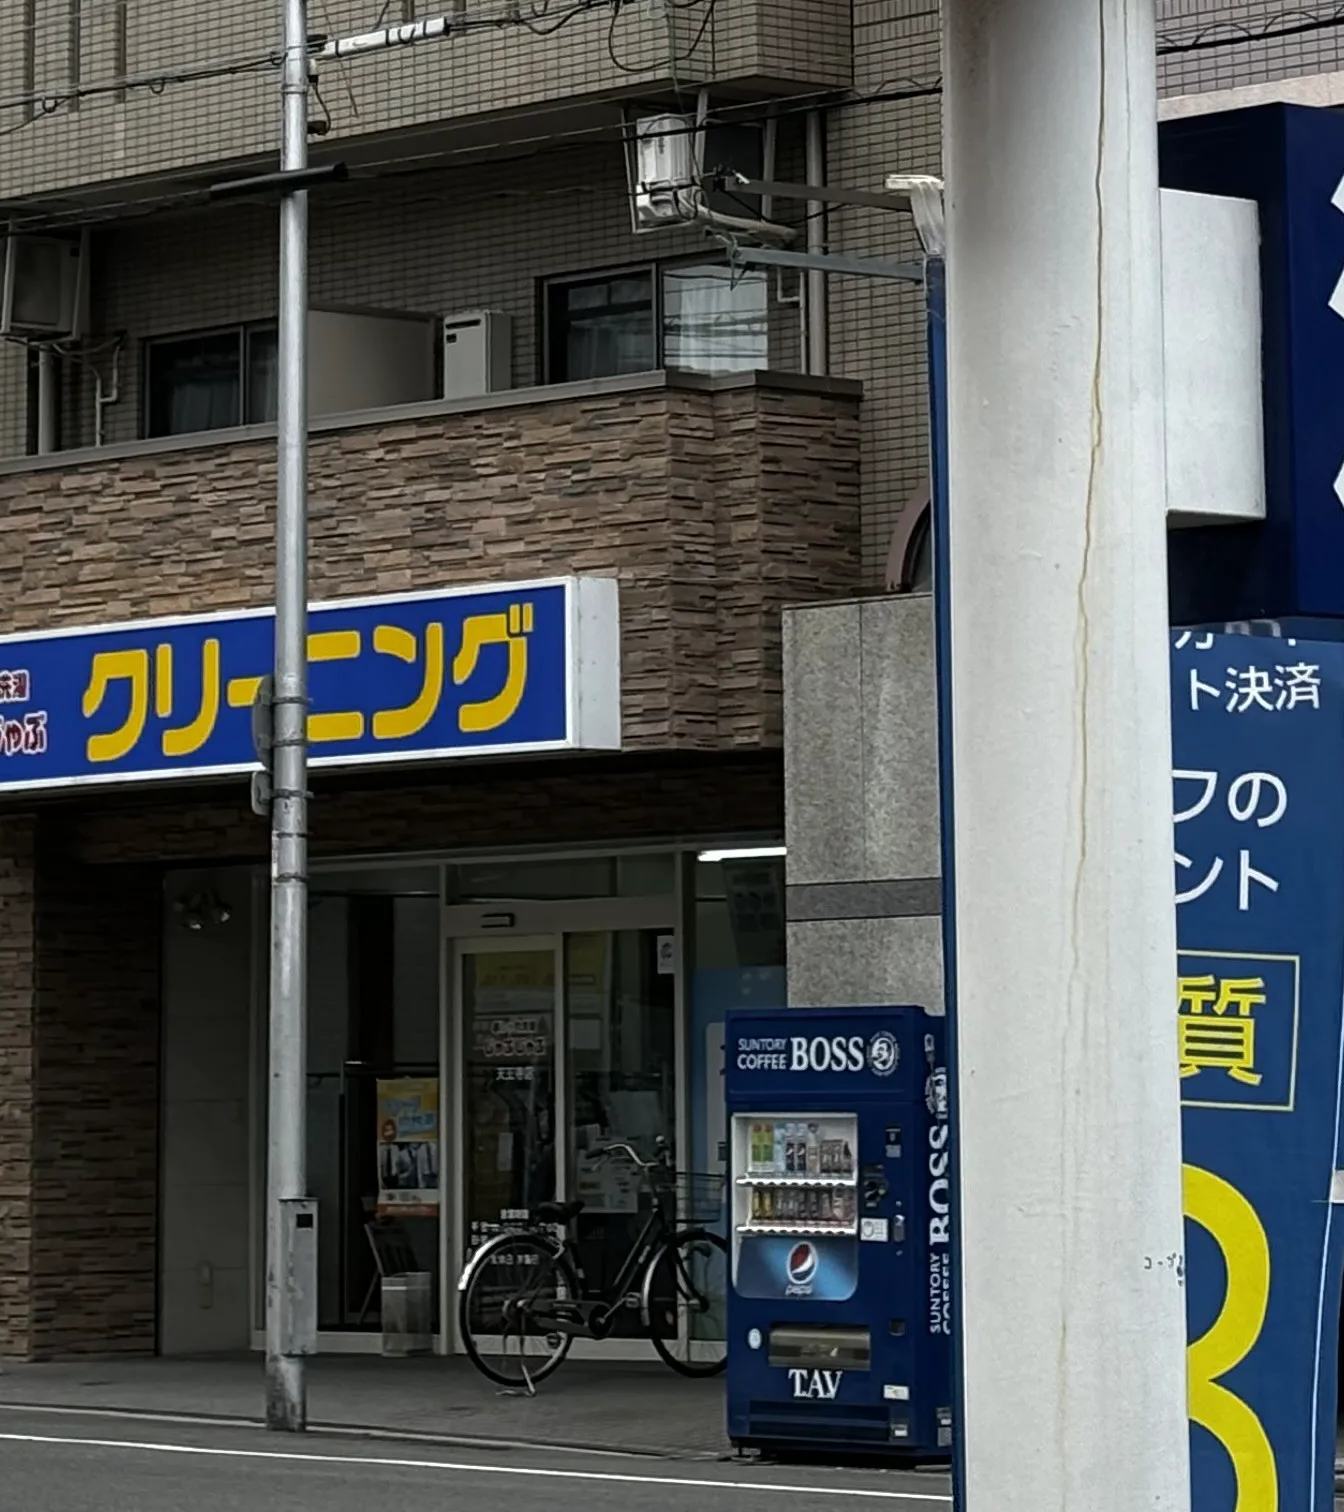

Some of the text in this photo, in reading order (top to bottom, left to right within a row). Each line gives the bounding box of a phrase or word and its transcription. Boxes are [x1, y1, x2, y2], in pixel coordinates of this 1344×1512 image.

[82, 601, 534, 763] クリーニング
[1190, 661, 1322, 713] ト決済
[737, 1038, 788, 1051] SUNTORY
[737, 1053, 787, 1070] COFFEE
[789, 1036, 865, 1072] BOSS
[929, 1252, 941, 1334] SUNTORY
